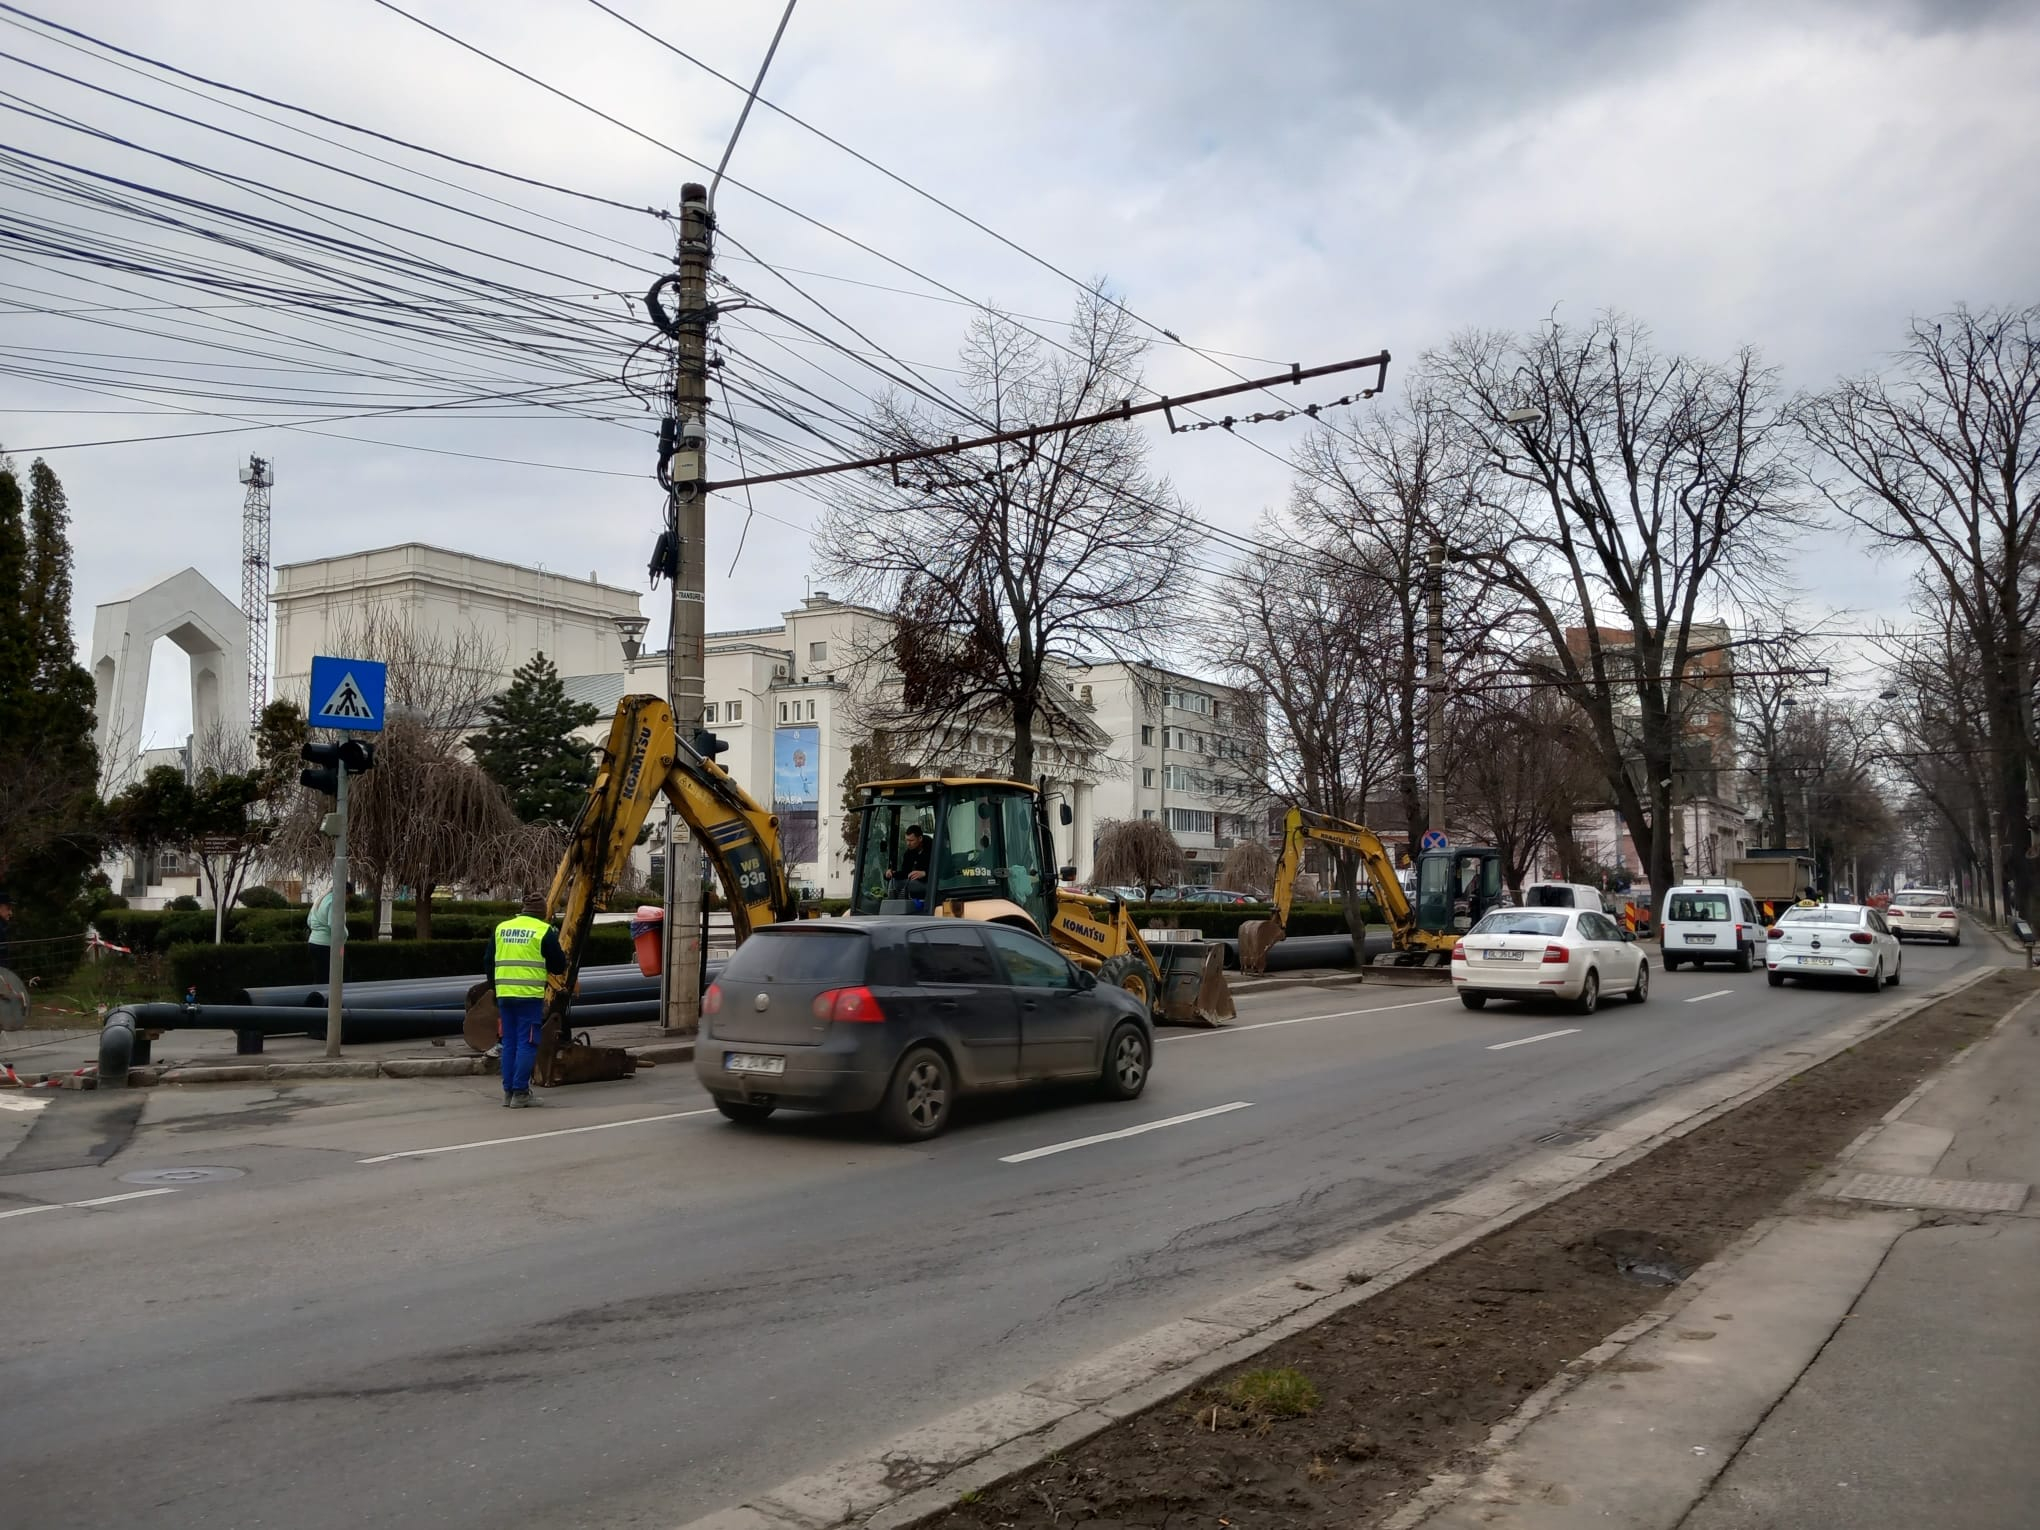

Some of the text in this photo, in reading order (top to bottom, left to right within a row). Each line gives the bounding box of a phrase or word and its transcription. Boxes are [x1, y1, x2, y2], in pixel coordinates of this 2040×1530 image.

[622, 726, 651, 800] KOMATSU
[740, 858, 760, 872] WB
[500, 928, 537, 939] ROMSIT
[1063, 917, 1105, 943] KOMATSU
